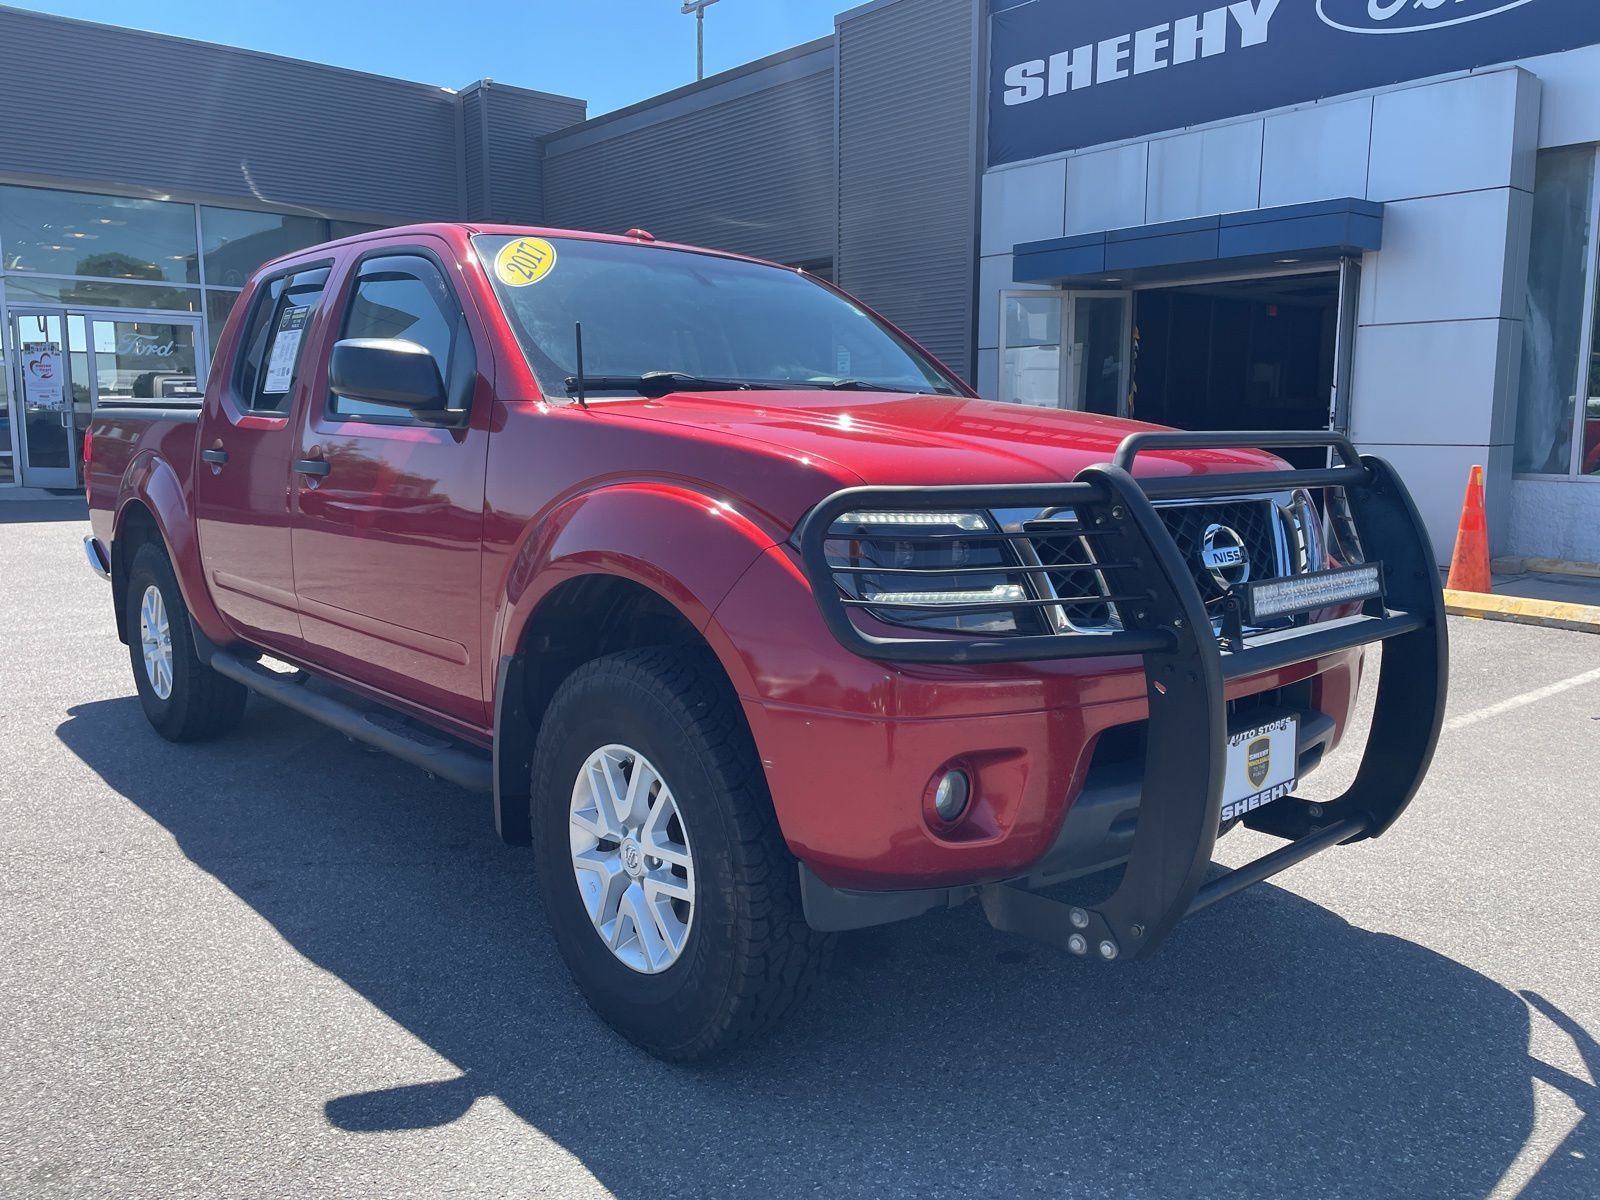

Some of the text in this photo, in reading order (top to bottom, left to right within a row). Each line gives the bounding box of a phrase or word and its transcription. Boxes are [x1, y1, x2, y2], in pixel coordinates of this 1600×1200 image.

[1003, 0, 1280, 107] SHEEHY
[506, 242, 547, 280] 2017
[117, 333, 174, 357] Ford
[1229, 729, 1255, 745] AUTO
[1221, 779, 1296, 822] SHEEHY
